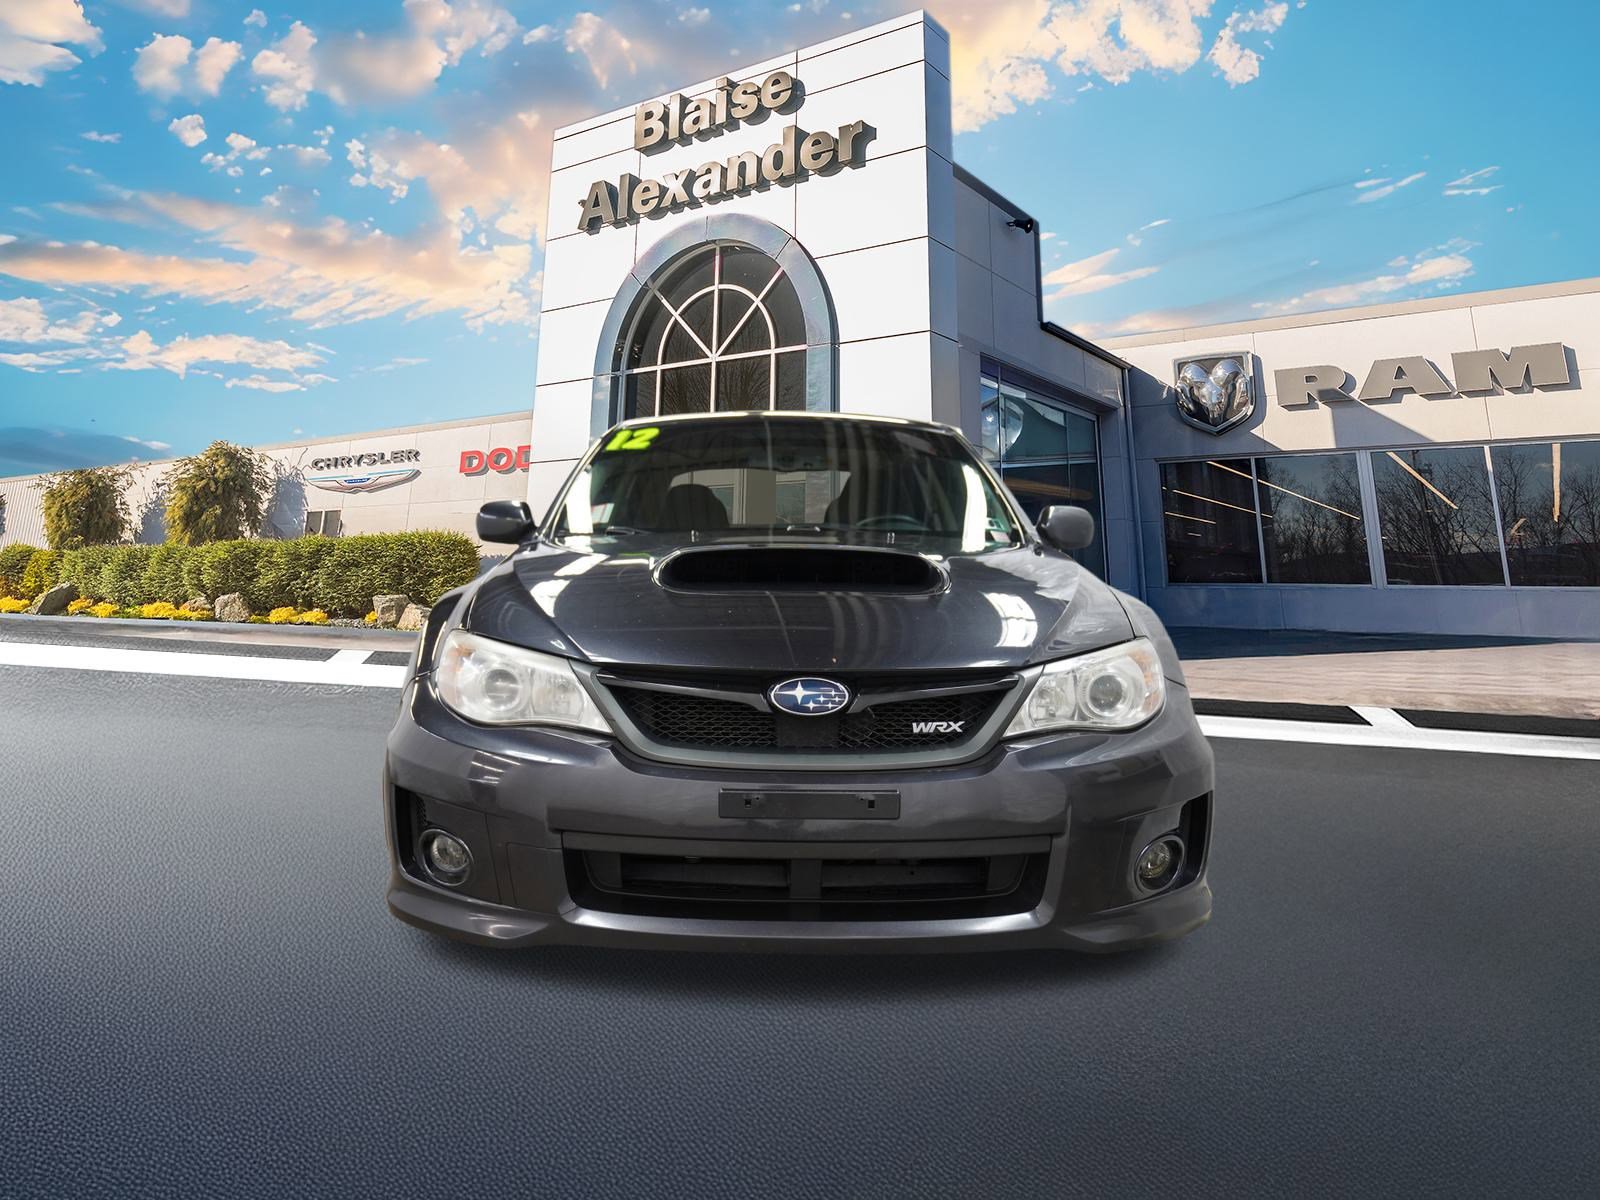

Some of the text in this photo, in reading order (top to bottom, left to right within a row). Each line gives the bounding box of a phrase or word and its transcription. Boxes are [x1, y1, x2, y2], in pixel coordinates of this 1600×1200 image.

[634, 71, 801, 155] Blaise
[578, 120, 874, 233] Alexander
[1274, 342, 1577, 408] RAM
[312, 448, 420, 471] CHRYSLER
[605, 427, 660, 451] 12
[912, 721, 965, 733] WRX
